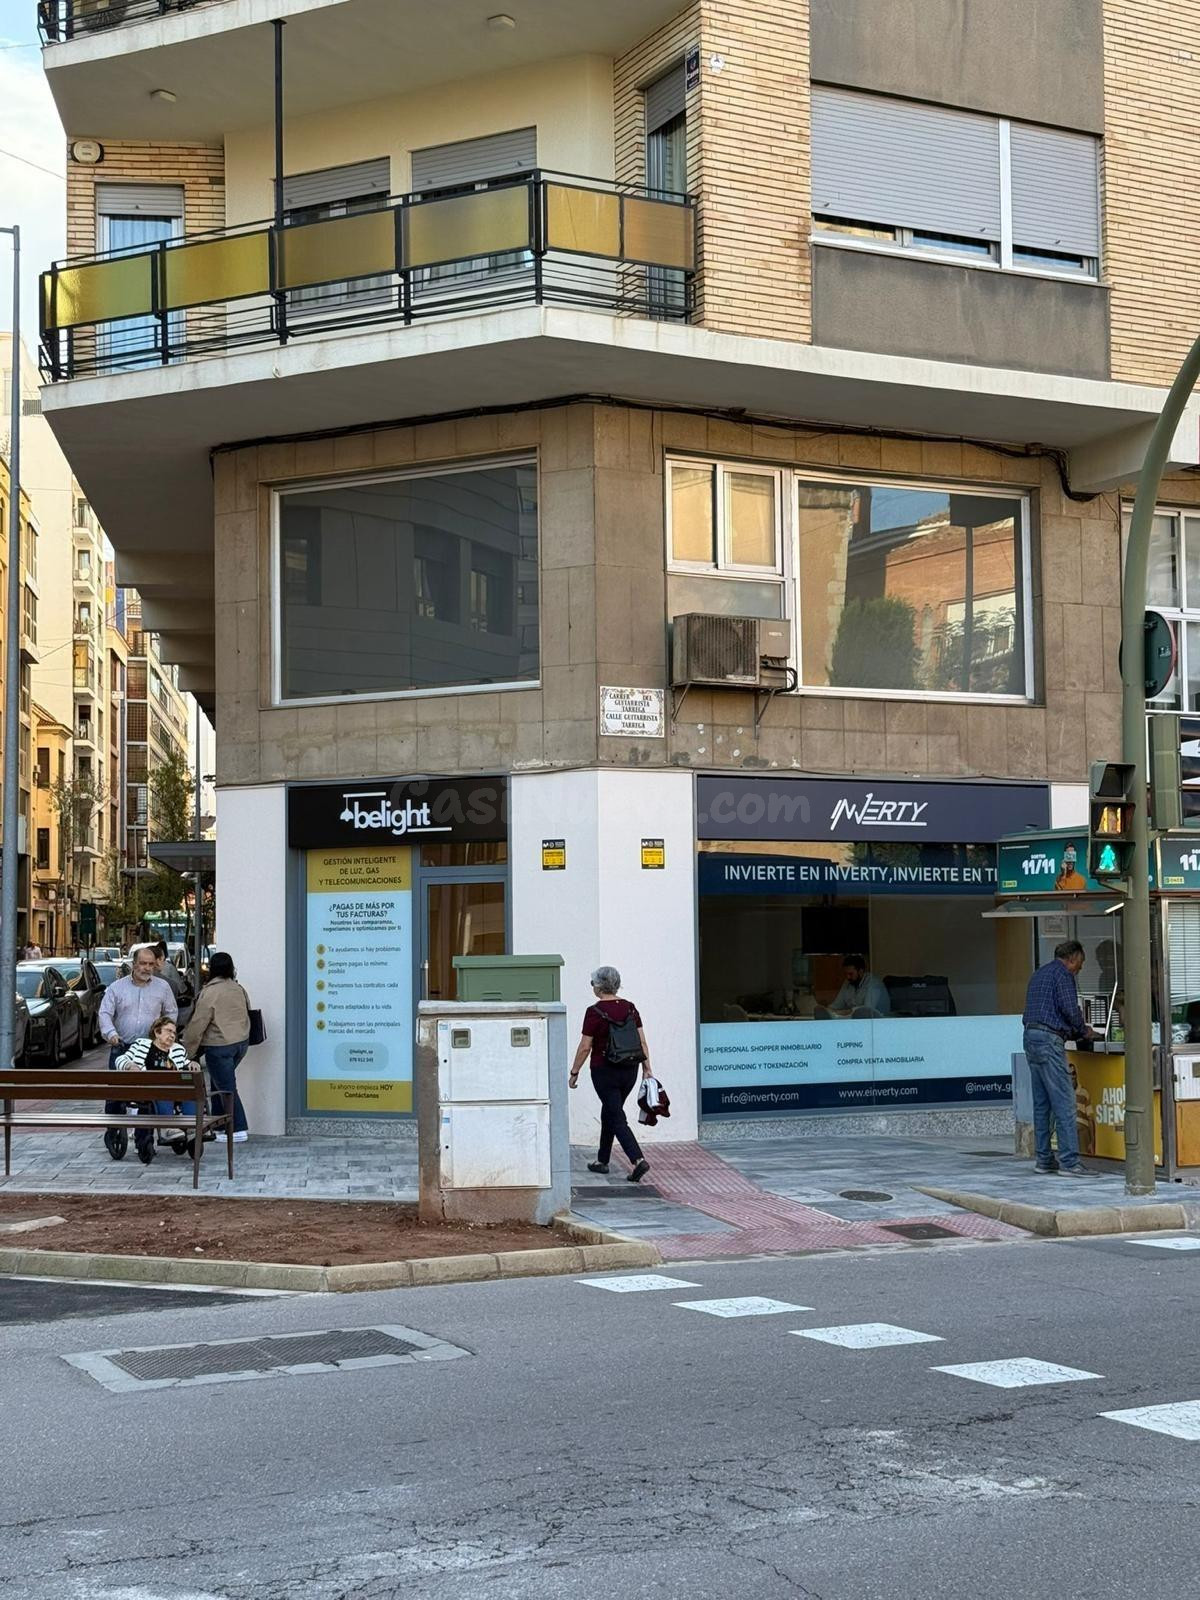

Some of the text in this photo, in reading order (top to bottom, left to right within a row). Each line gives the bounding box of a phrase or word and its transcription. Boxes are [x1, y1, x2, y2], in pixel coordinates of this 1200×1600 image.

[354, 799, 431, 836] belight
[323, 856, 397, 865] GESTIÓN INTELIGENTE
[1022, 858, 1055, 875] 11/11
[1180, 854, 1200, 870] 11
[325, 876, 402, 885] TELECOMUNICACIONES
[724, 865, 795, 880] INVIERTE
[800, 866, 820, 880] EN
[963, 868, 982, 882] EN
[329, 903, 354, 912] ¿PAGAS
[366, 901, 380, 909] MÁS
[704, 1064, 756, 1072] CROWDFUNDING
[721, 1091, 800, 1104] info@inverty.com
[839, 1086, 918, 1098] www.einverty.com
